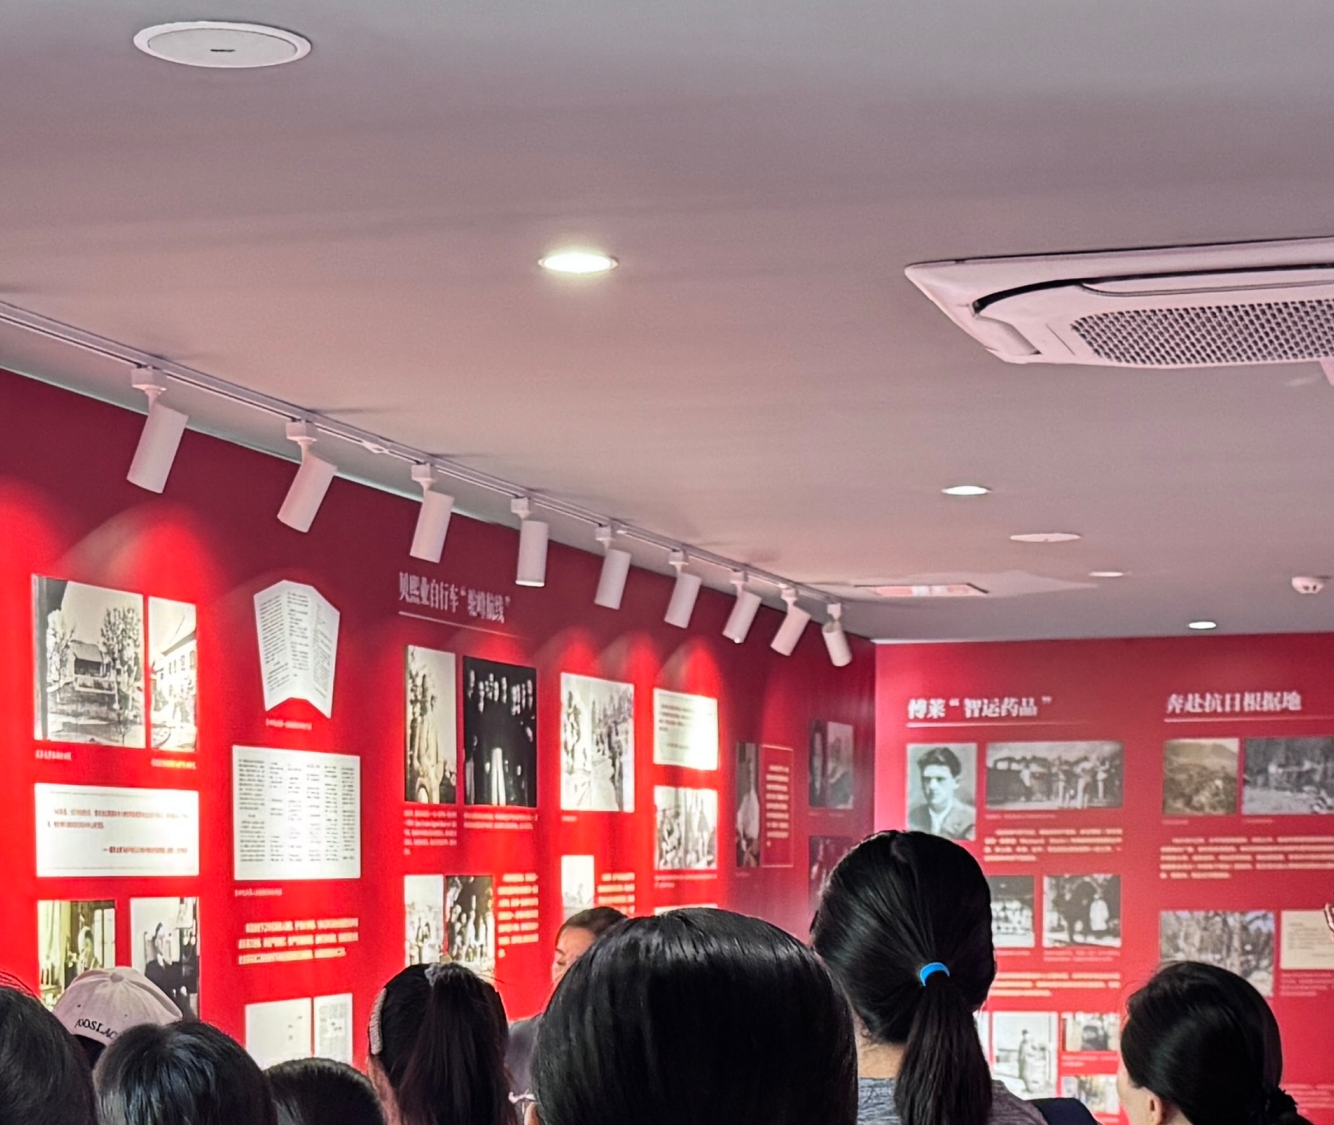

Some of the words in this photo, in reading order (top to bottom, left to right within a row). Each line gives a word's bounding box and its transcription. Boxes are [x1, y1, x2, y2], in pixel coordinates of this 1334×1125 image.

[1167, 691, 1302, 714] 奔赴抗日根据地
